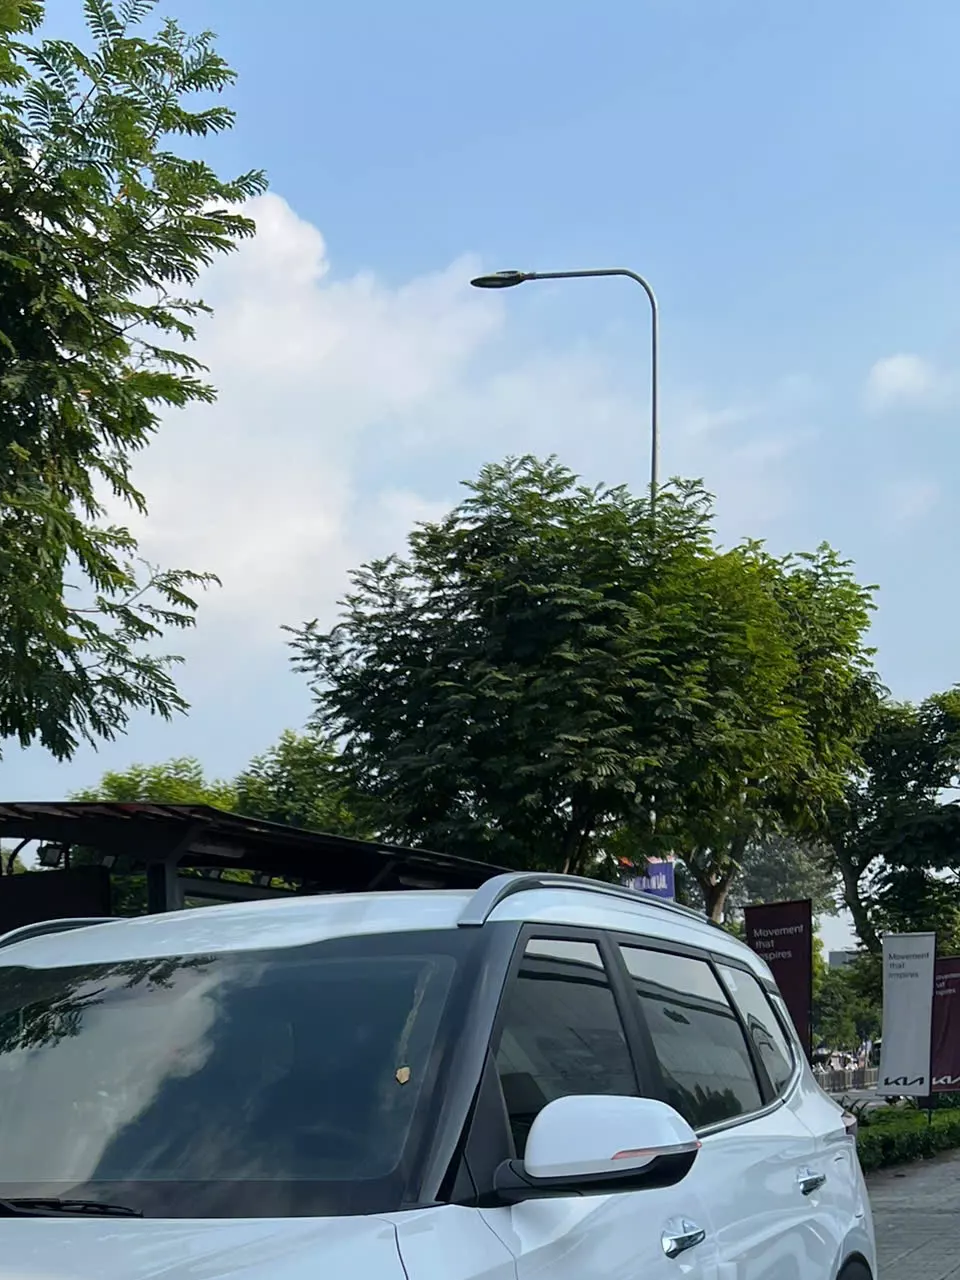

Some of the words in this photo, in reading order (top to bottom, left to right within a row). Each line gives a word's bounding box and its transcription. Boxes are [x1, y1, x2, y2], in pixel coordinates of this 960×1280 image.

[753, 924, 804, 938] Movement
[759, 950, 793, 960] spires
[884, 1076, 925, 1086] KIA
